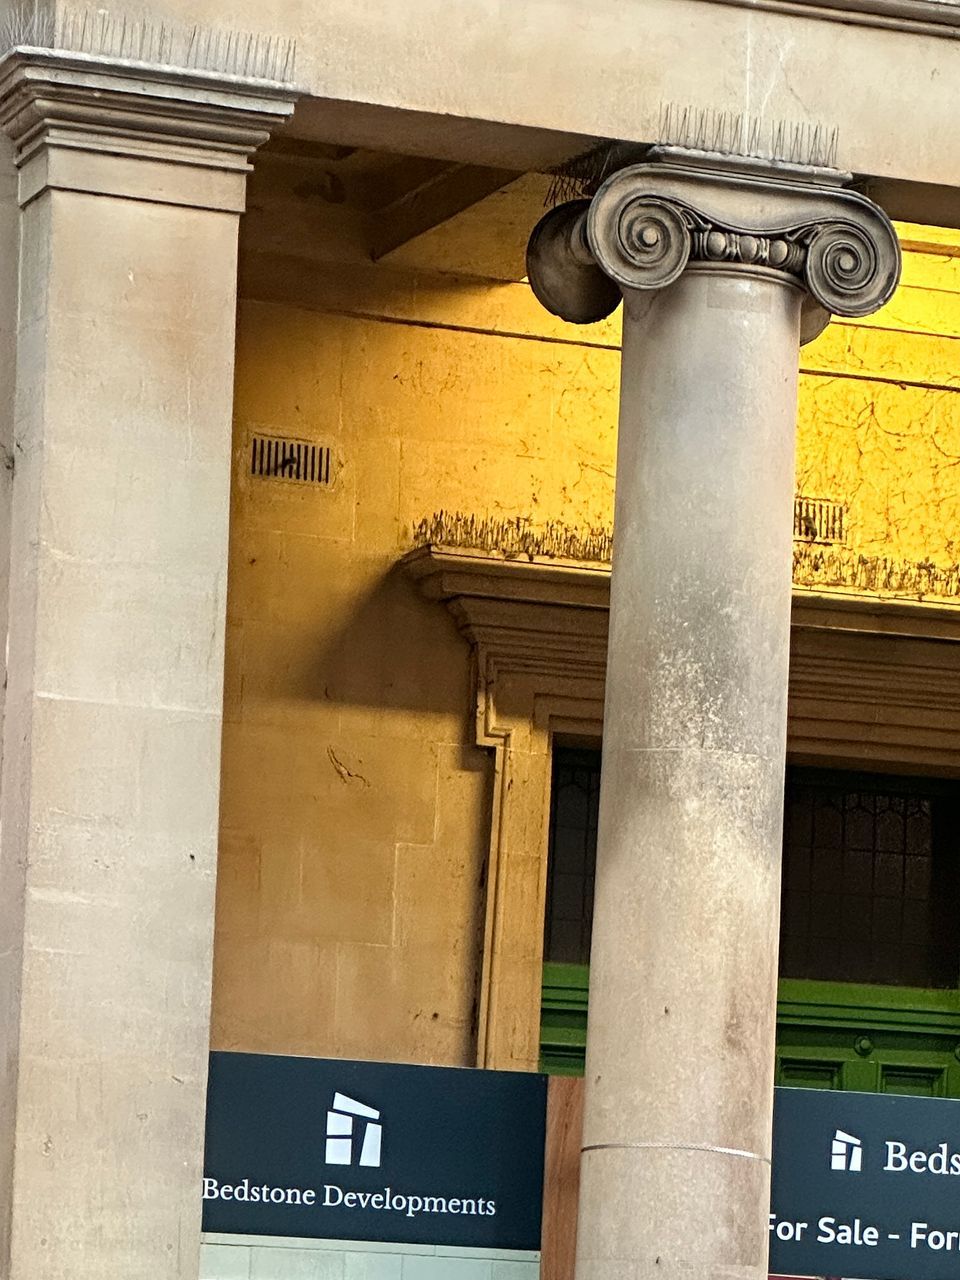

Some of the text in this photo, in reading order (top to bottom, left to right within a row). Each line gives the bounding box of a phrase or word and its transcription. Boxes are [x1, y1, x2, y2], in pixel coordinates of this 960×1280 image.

[202, 1177, 496, 1218] Bedstone Developments
[816, 1216, 879, 1246] Sale
